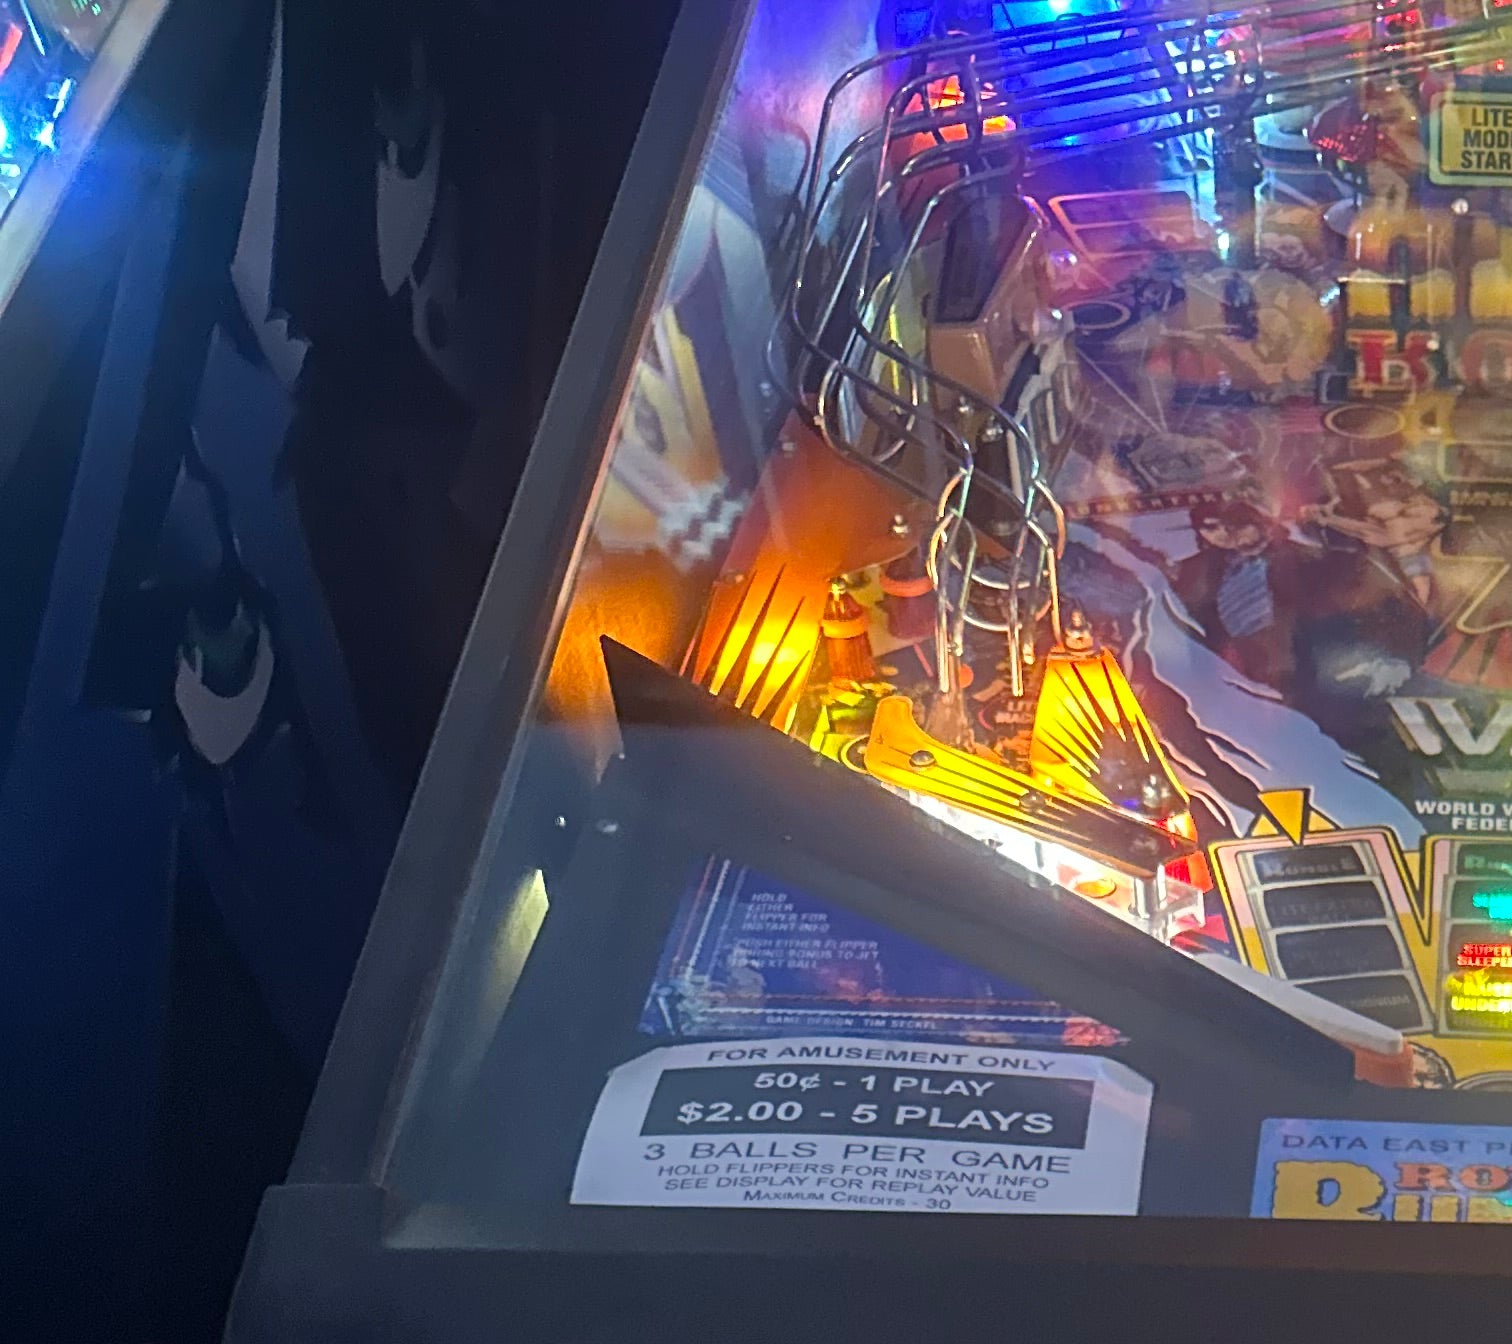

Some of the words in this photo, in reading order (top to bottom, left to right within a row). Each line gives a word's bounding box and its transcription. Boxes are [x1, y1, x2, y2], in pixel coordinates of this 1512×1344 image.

[1414, 801, 1496, 816] WORLD
[1463, 944, 1512, 957] SUPER
[707, 1048, 768, 1062] FOR
[776, 1045, 968, 1066] AMUSEMENT
[977, 1055, 1056, 1072] ONLY
[753, 1072, 821, 1092] 50¢
[860, 1075, 877, 1092] 1
[893, 1075, 995, 1098] PLAY
[676, 1101, 803, 1126] $2.00
[851, 1104, 878, 1125] 5
[895, 1104, 1054, 1135] PLAYS
[1282, 1134, 1368, 1151] DATA
[1383, 1137, 1467, 1155] EAST
[643, 1143, 665, 1161] 3
[690, 1141, 818, 1160] BALLS
[842, 1143, 926, 1165] PER
[951, 1150, 1073, 1175] GAME
[657, 1165, 720, 1178] HOLD
[725, 1162, 835, 1176] FLIPPERS
[841, 1166, 889, 1178] FOR
[895, 1168, 990, 1186] INSTANT
[996, 1175, 1050, 1190] INFO
[664, 1178, 708, 1191] SEE
[715, 1176, 810, 1189] DISPLAY
[815, 1177, 864, 1190] FOR
[871, 1180, 959, 1197] REPLAY
[965, 1186, 1038, 1203] VALUE
[924, 1198, 952, 1211] 30
